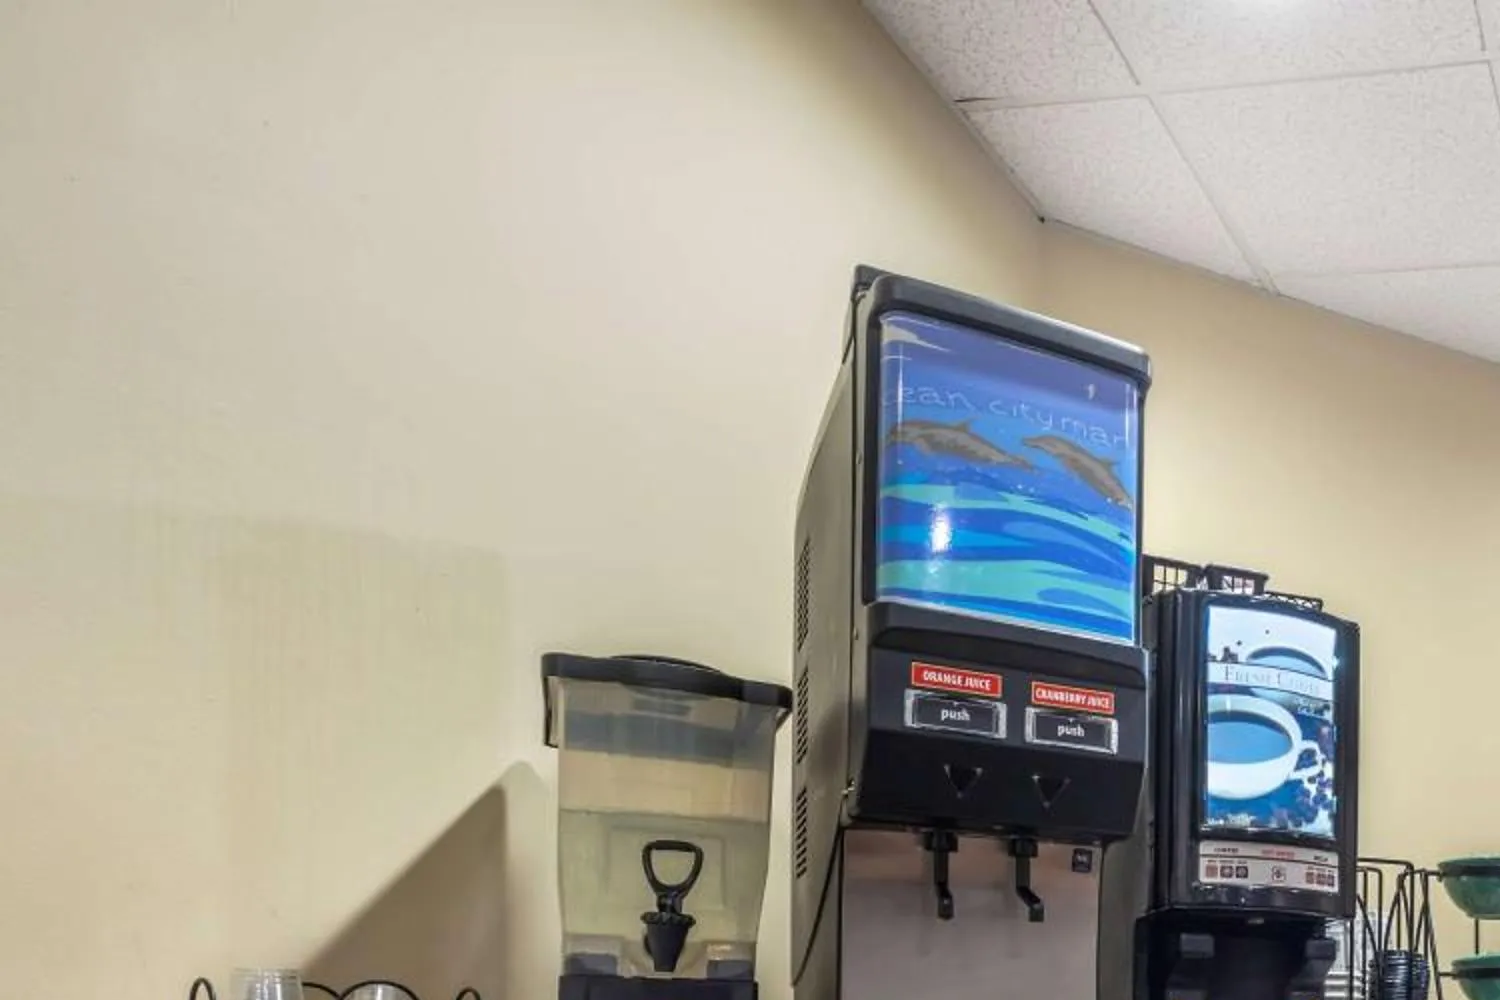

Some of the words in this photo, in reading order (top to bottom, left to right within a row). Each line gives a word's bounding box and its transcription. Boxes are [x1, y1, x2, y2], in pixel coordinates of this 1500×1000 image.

[923, 669, 963, 686] ORANGE
[965, 676, 993, 691] JUICE
[941, 708, 971, 721] push
[1057, 724, 1085, 737] push
